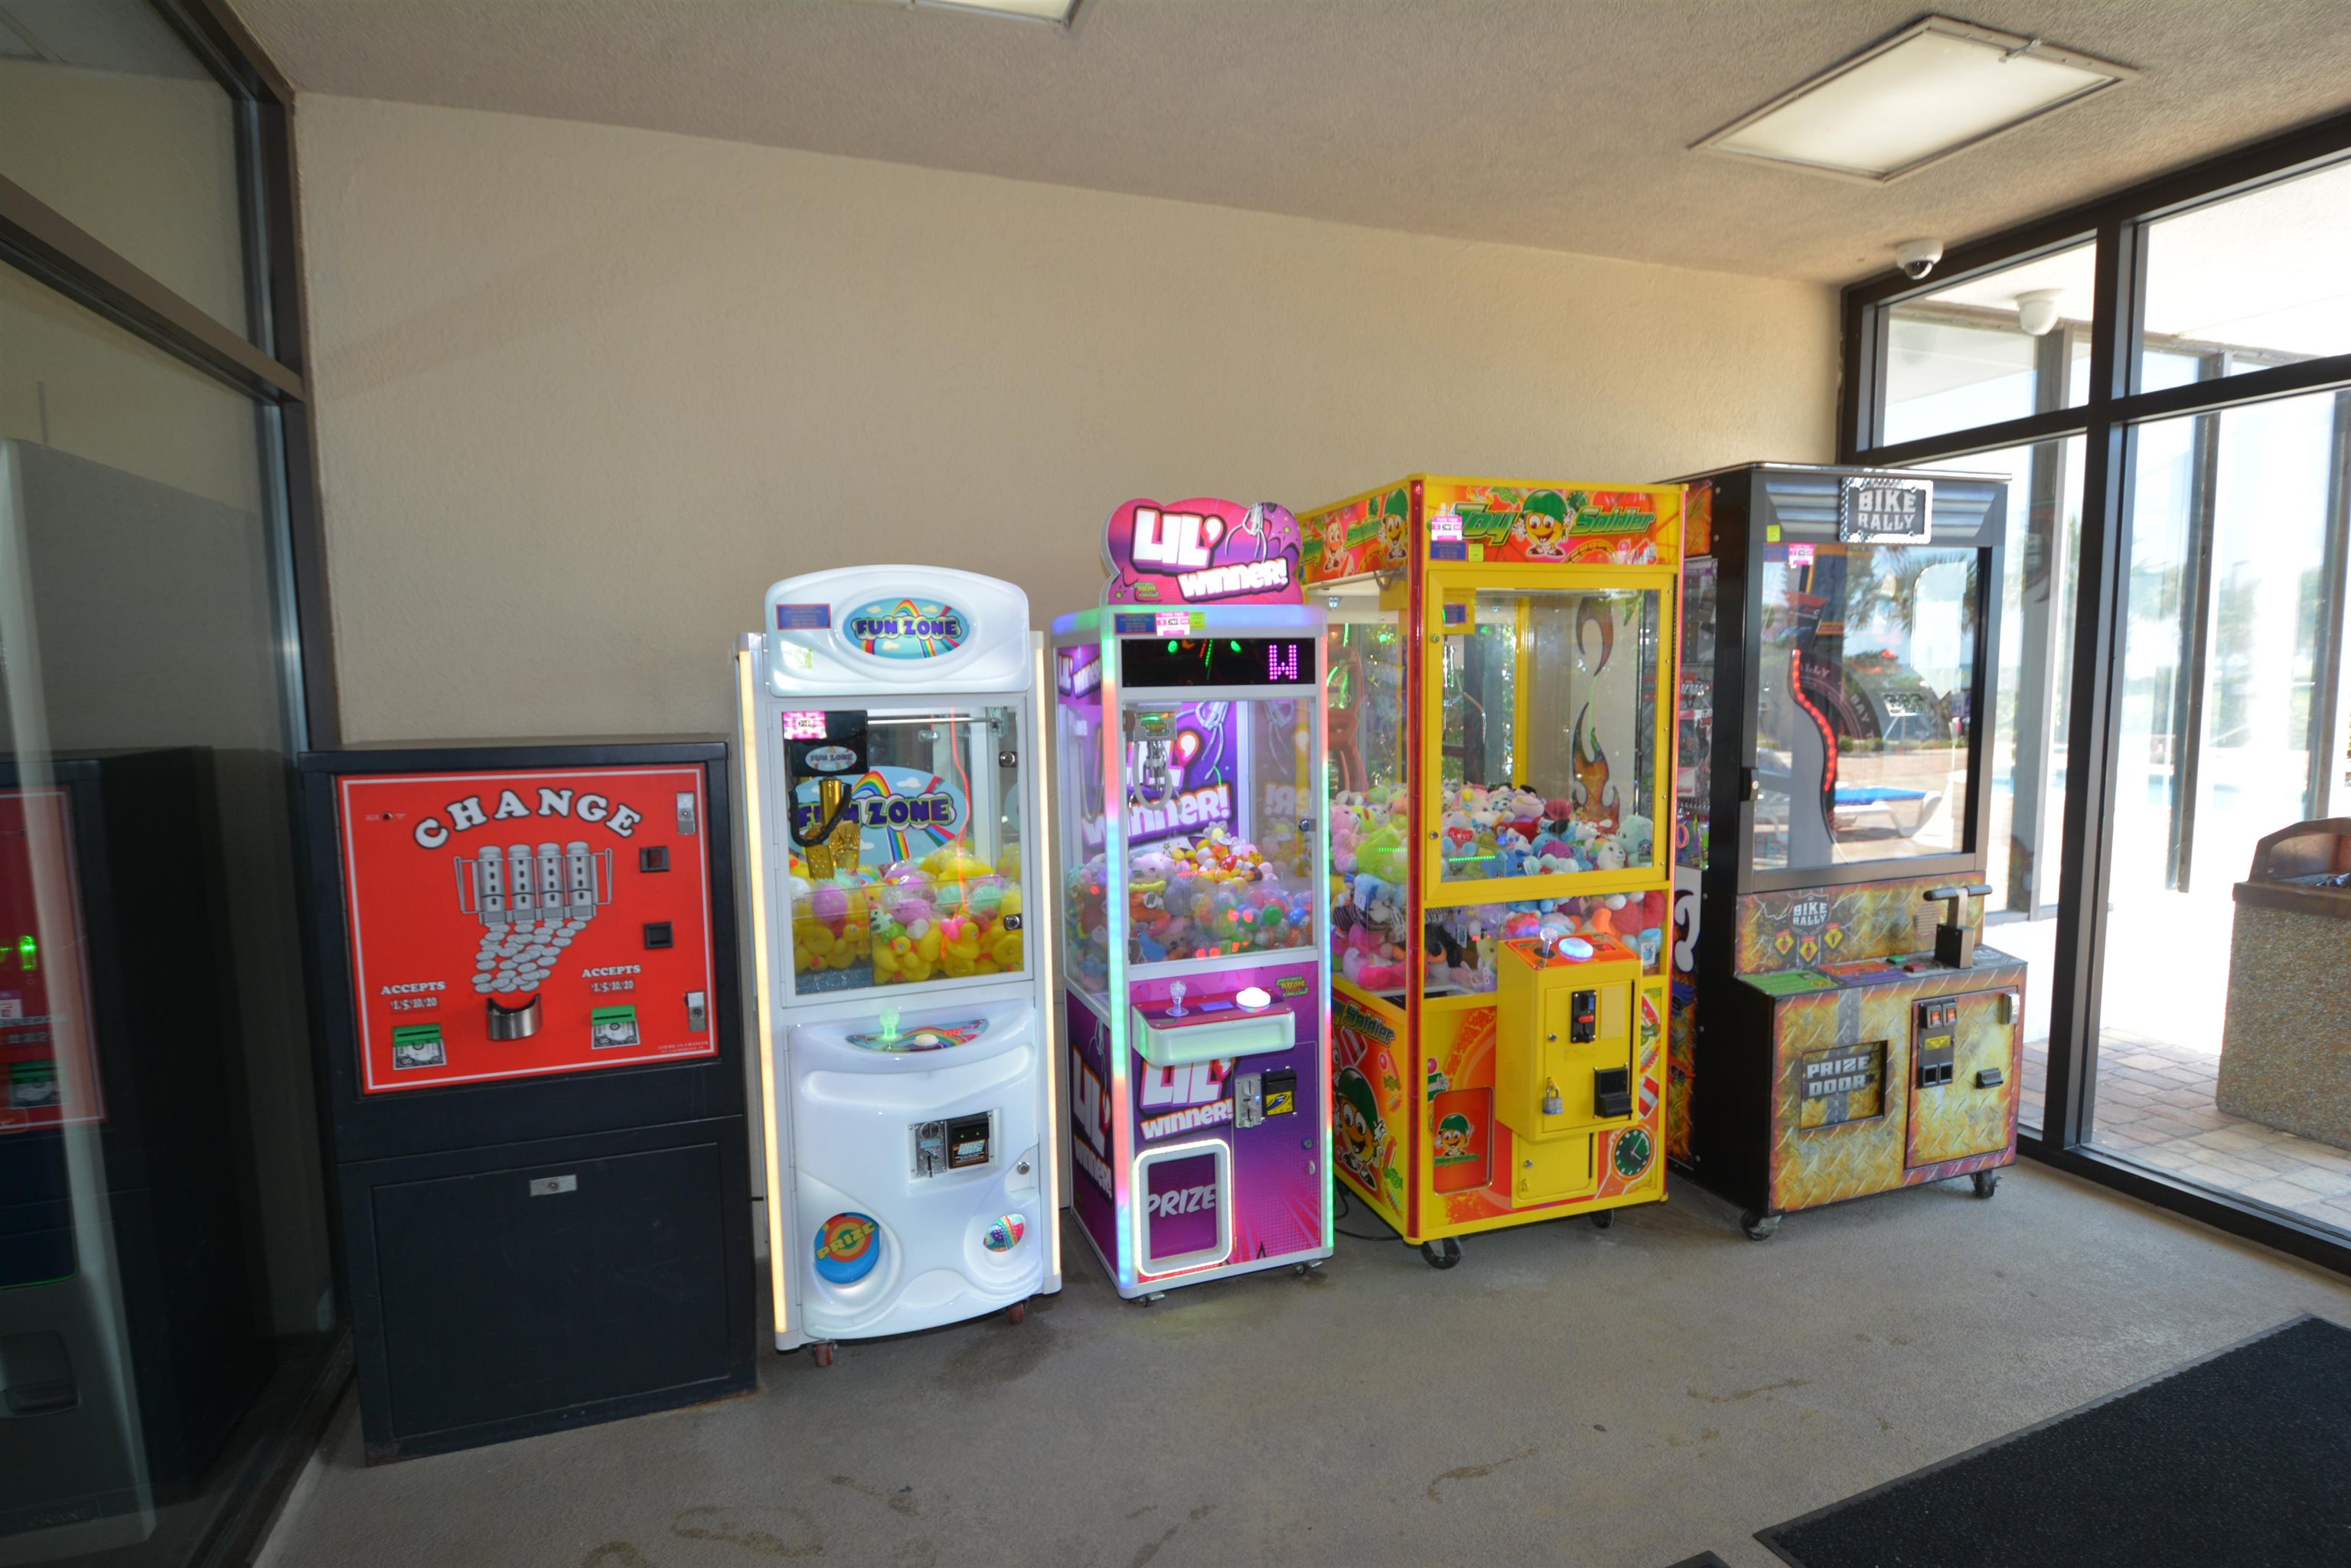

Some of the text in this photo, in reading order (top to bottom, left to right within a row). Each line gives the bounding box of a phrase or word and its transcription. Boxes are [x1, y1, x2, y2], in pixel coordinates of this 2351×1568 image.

[1857, 489, 1917, 513] BIKE
[1453, 502, 1519, 546] Toy
[1569, 506, 1655, 535] Soldier
[1857, 512, 1916, 531] RALLY
[1133, 509, 1222, 567] LIL'
[856, 619, 957, 636] FUN ZONE
[1268, 644, 1298, 680] W
[415, 788, 641, 848] CHANGE
[798, 798, 950, 827] FN ZONE
[1792, 914, 1827, 927] RALLY
[1793, 901, 1828, 917] BIKE
[582, 964, 641, 979] ACCEPTS
[380, 981, 446, 996] ACCEPTS
[1342, 1001, 1397, 1048] Soldier
[1807, 1055, 1870, 1079] PRIZE
[1808, 1074, 1867, 1097] DOOR
[1148, 1183, 1216, 1218] PRIZE
[815, 1221, 876, 1262] PRIZE
